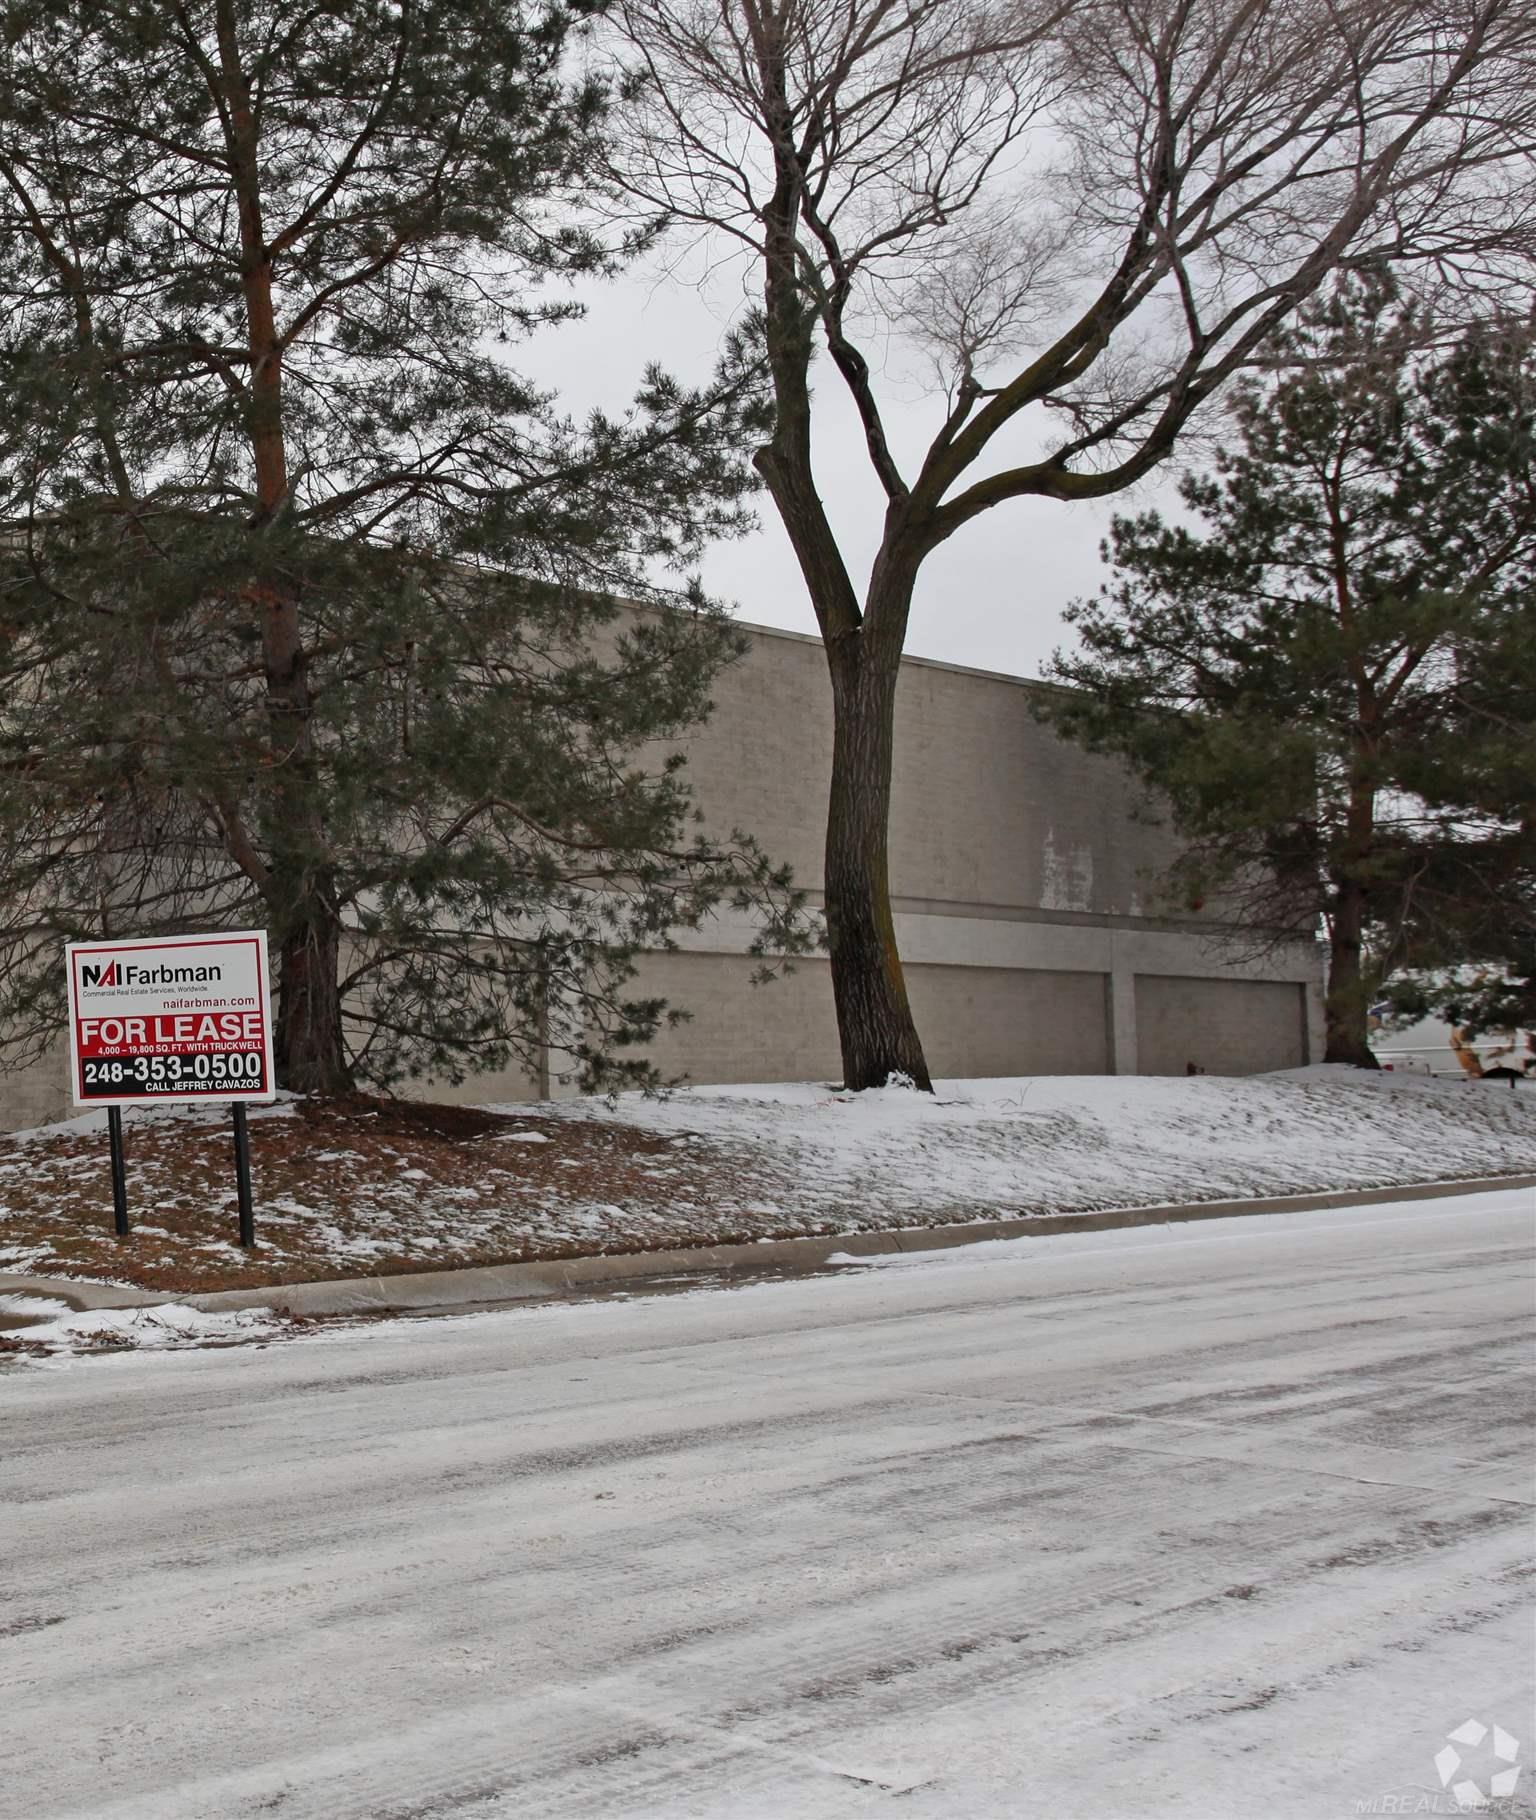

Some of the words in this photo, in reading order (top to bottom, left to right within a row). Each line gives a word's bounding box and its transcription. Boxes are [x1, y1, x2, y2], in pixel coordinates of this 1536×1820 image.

[82, 960, 122, 987] NAI
[127, 964, 221, 985] Farbman
[82, 989, 116, 998] Commercial
[117, 988, 129, 996] Real
[163, 997, 255, 1009] naifarbman.com
[81, 1018, 147, 1046] FOR
[155, 1013, 262, 1043] LEASE
[98, 1046, 120, 1055] 4,000
[129, 1045, 154, 1054] 19,800
[156, 1044, 170, 1054] SQ.
[172, 1044, 185, 1052] FT.
[187, 1043, 208, 1051] WITH
[85, 1052, 261, 1084] 248-353-0500
[145, 1082, 170, 1092] CALL
[172, 1081, 214, 1091] JEFFREY
[215, 1079, 261, 1090] CAVAZOS
